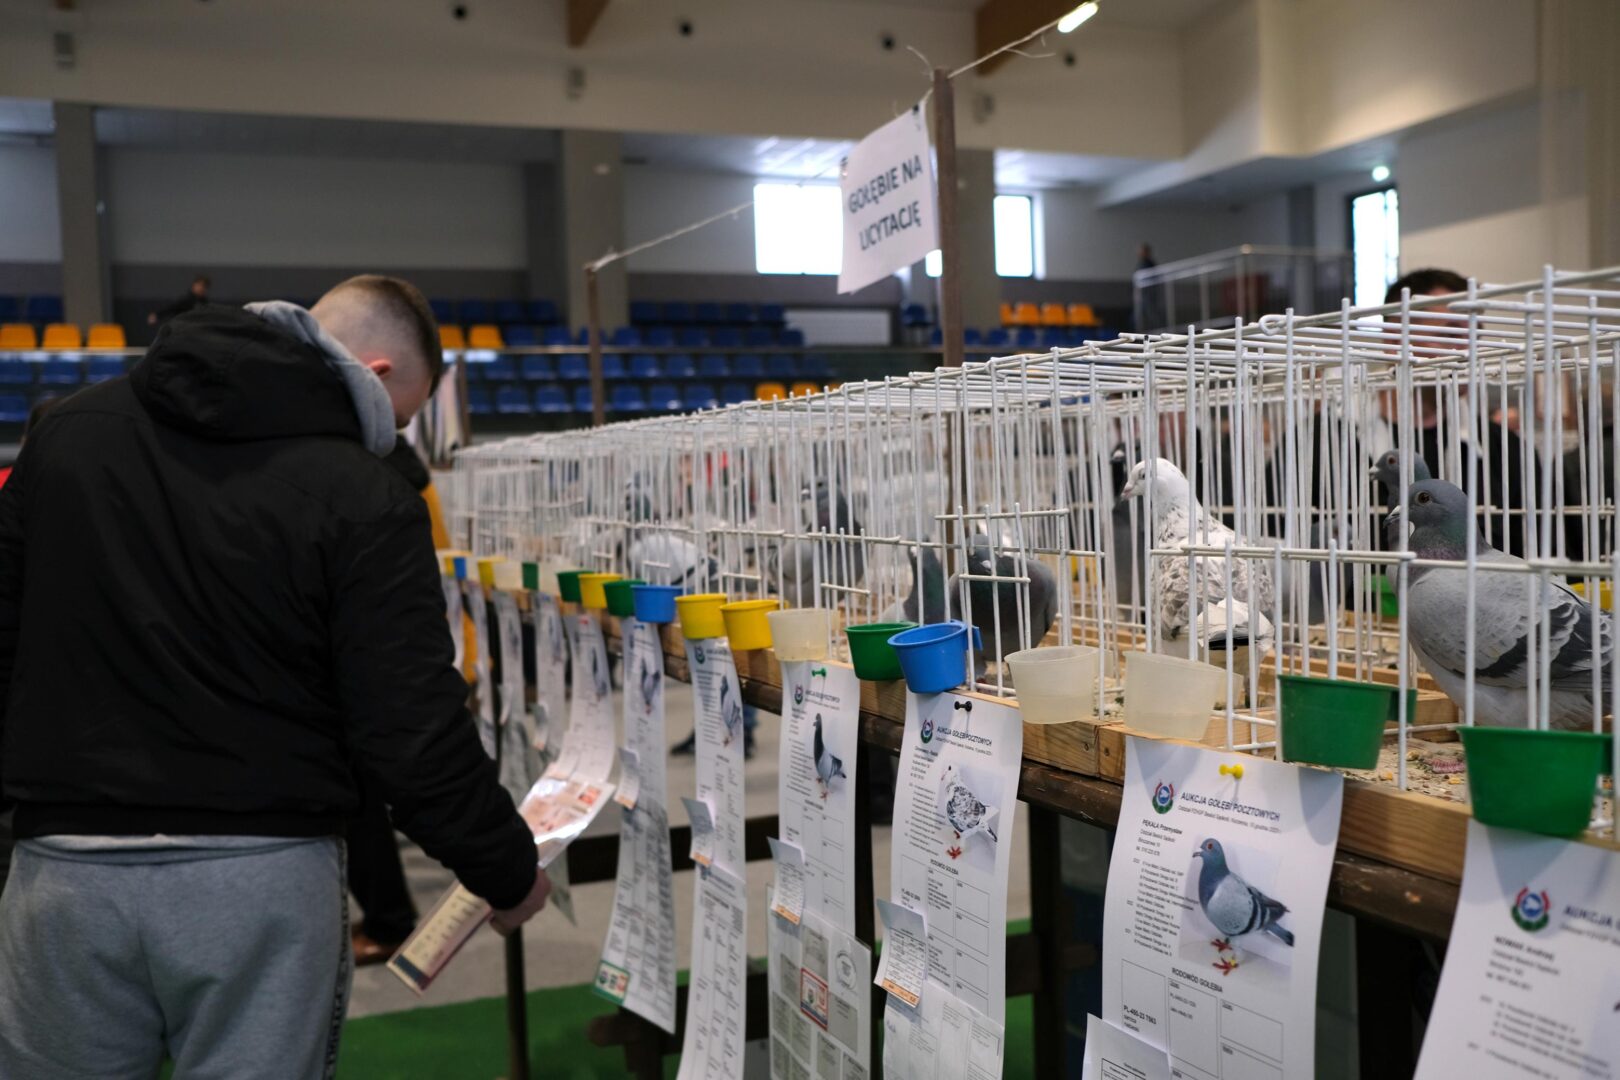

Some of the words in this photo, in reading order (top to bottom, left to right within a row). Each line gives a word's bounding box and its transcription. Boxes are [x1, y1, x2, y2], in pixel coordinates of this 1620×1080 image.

[848, 167, 899, 214] GOŁĘBIE
[902, 155, 923, 184] NA
[859, 201, 922, 251] LICYTACJĘ
[1181, 792, 1207, 805] AUKCJA
[1208, 798, 1233, 811] GOŁĘBI
[1233, 803, 1280, 822] POCZTOWYCH
